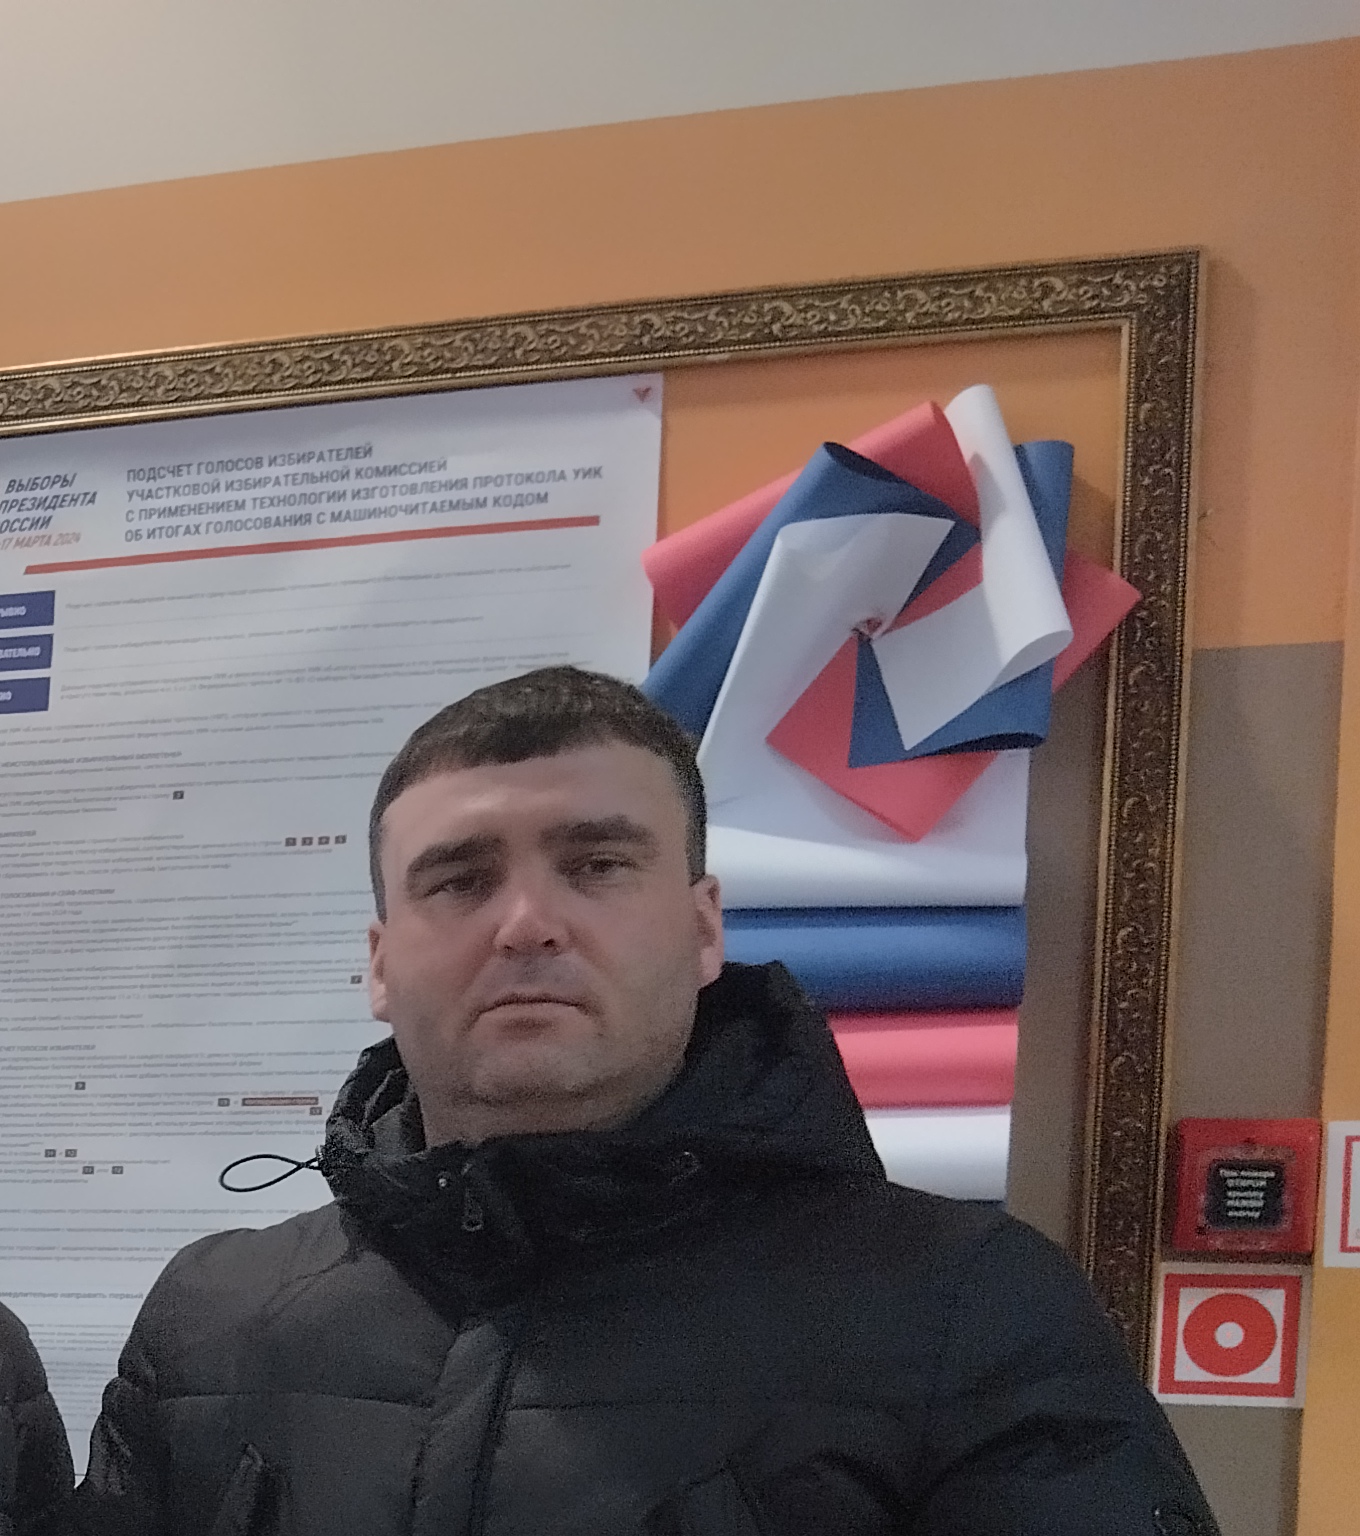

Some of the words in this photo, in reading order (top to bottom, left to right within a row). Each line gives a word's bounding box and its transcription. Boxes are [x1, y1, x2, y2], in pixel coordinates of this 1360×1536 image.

[4, 472, 78, 495] ВЫБОРЫ
[126, 463, 194, 484] ПОДСЧЕТ
[196, 456, 264, 476] ГОЛОСОВ
[267, 442, 373, 468] ИЗБИРАТЕЛЕЙ
[126, 478, 222, 502] УЧАСТКОВОЙ
[224, 465, 351, 493] ИЗБИРАТЕЛЬНОЙ
[354, 457, 448, 480] КОМИССИЕЙ
[125, 508, 135, 523] С
[137, 498, 247, 522] ПРИМЕНЕНИЕМ
[250, 488, 348, 511] ТЕХНОЛОГИИ
[351, 477, 468, 501] ИЗГОТОВЛЕНИЯ
[472, 468, 568, 489] ПРОТОКОЛА
[572, 466, 603, 480] УИК
[124, 529, 143, 543] ОБ
[146, 522, 202, 541] ИТОГАХ
[205, 512, 312, 535] ГОЛОСОВАНИЯ
[316, 511, 326, 525] С
[329, 497, 488, 523] МАШИНОЧИТАЕМЫМ
[491, 491, 550, 509] КОДОМ
[13, 535, 52, 549] МАРТА
